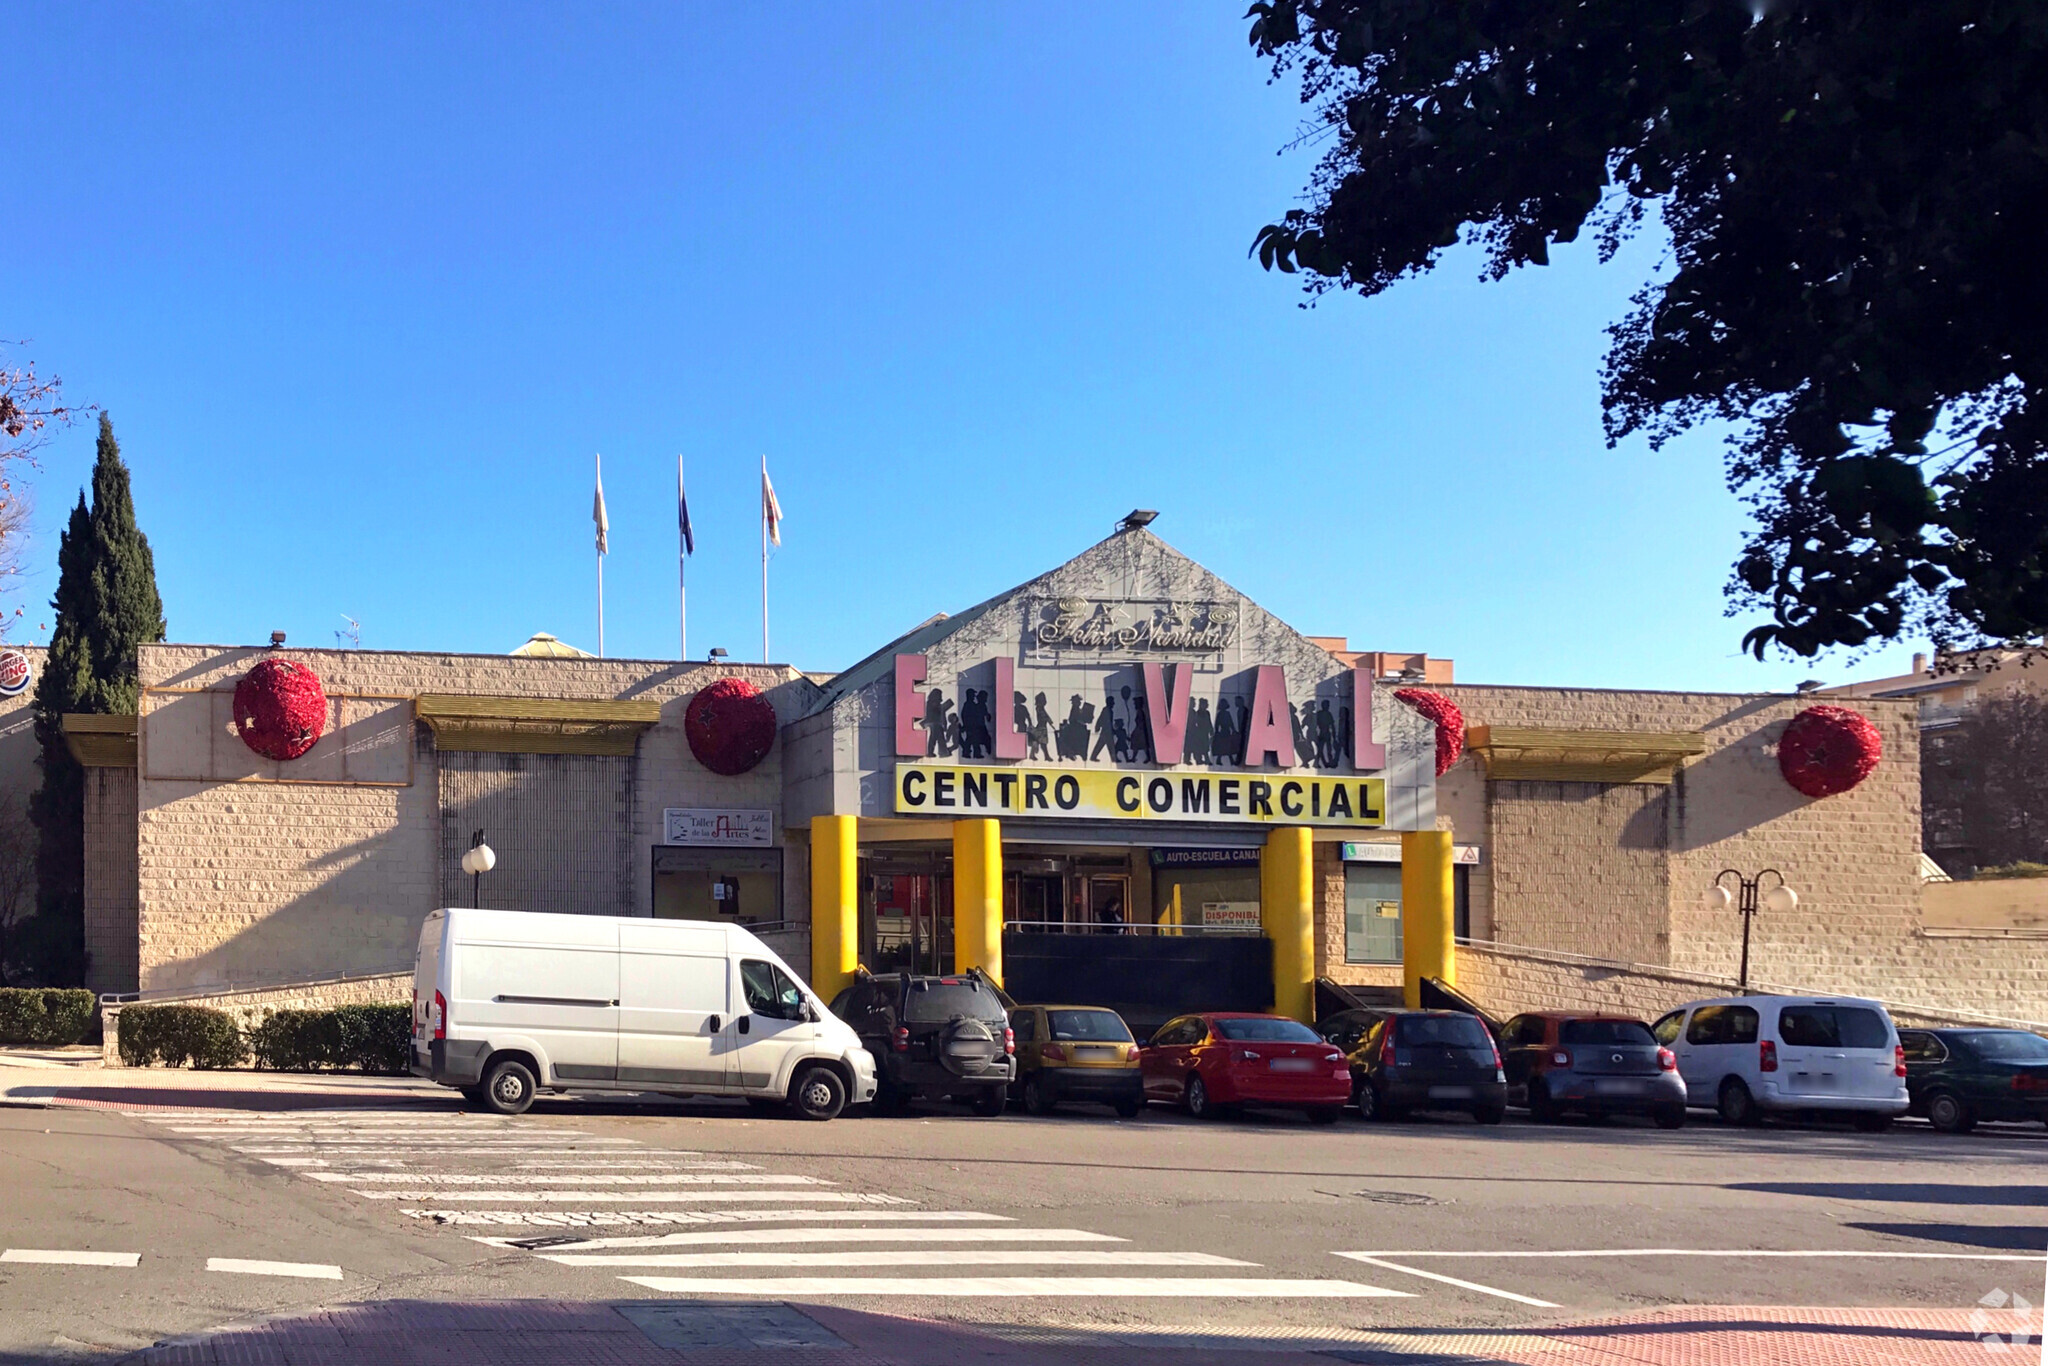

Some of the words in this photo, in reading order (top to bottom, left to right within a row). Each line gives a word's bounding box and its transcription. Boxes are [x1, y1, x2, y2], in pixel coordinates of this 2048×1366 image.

[1118, 614, 1240, 648] Navidad
[0, 656, 25, 671] URGER
[895, 653, 1028, 761] EL
[1142, 661, 1387, 771] VAL
[902, 770, 1081, 810] CENTRO
[1116, 775, 1380, 820] COMERCIAL
[690, 817, 715, 828] Taller
[1166, 850, 1231, 862] AUTO-ESCUELA
[1205, 911, 1259, 920] DISPONIBL
